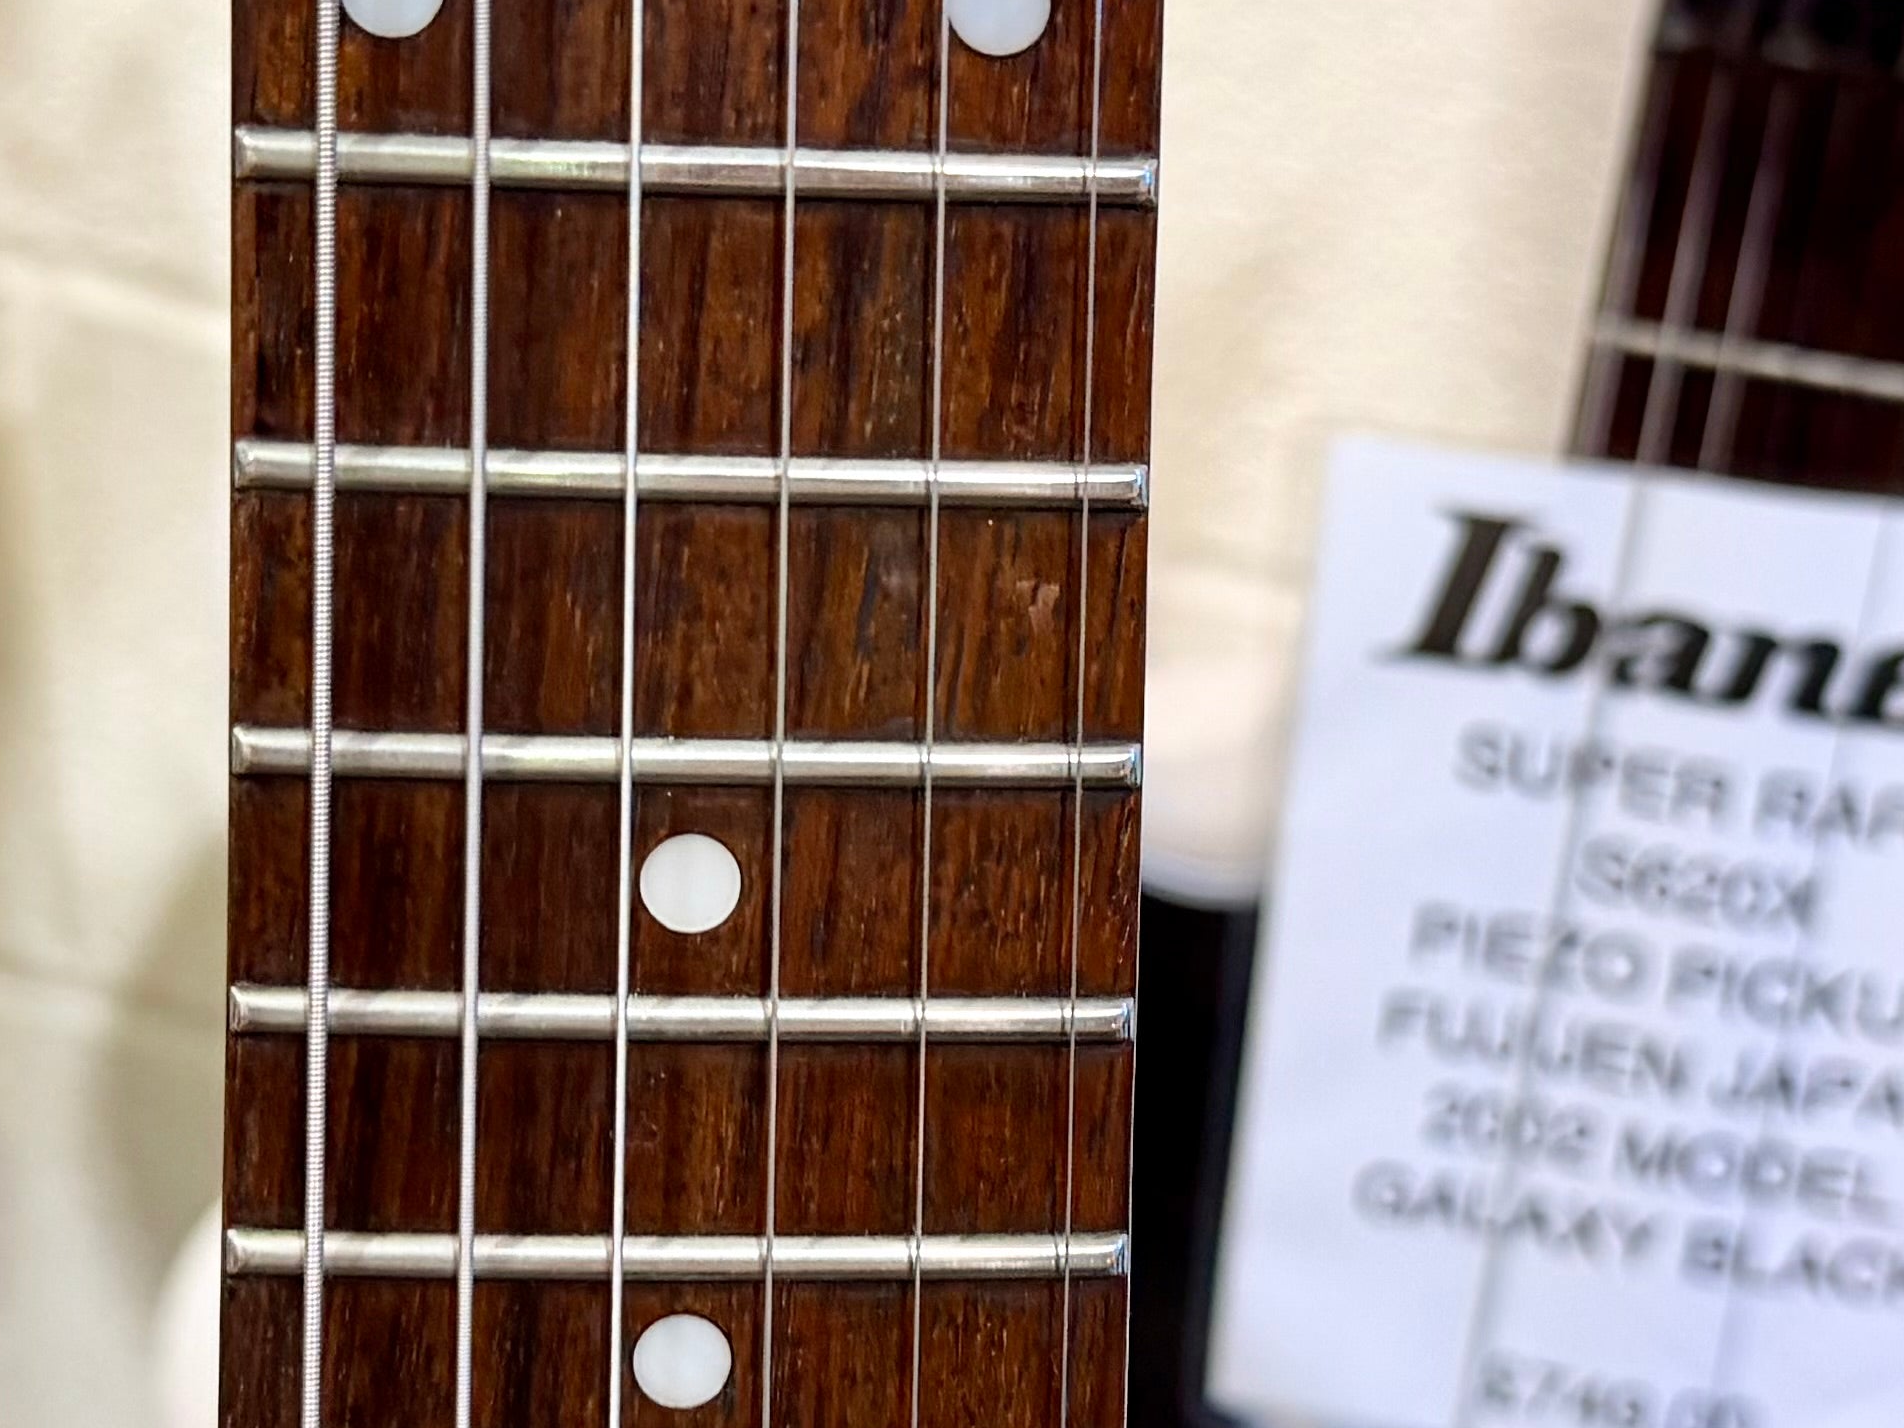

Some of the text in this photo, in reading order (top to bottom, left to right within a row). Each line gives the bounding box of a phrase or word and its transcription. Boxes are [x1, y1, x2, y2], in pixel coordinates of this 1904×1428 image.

[1456, 719, 1731, 829] SUPER
[1578, 834, 1819, 934] S620X
[1408, 901, 1655, 1004] PIEZO
[1421, 1080, 1893, 1226] 2002 MODEL
[1350, 1157, 1665, 1267] GALAXY
